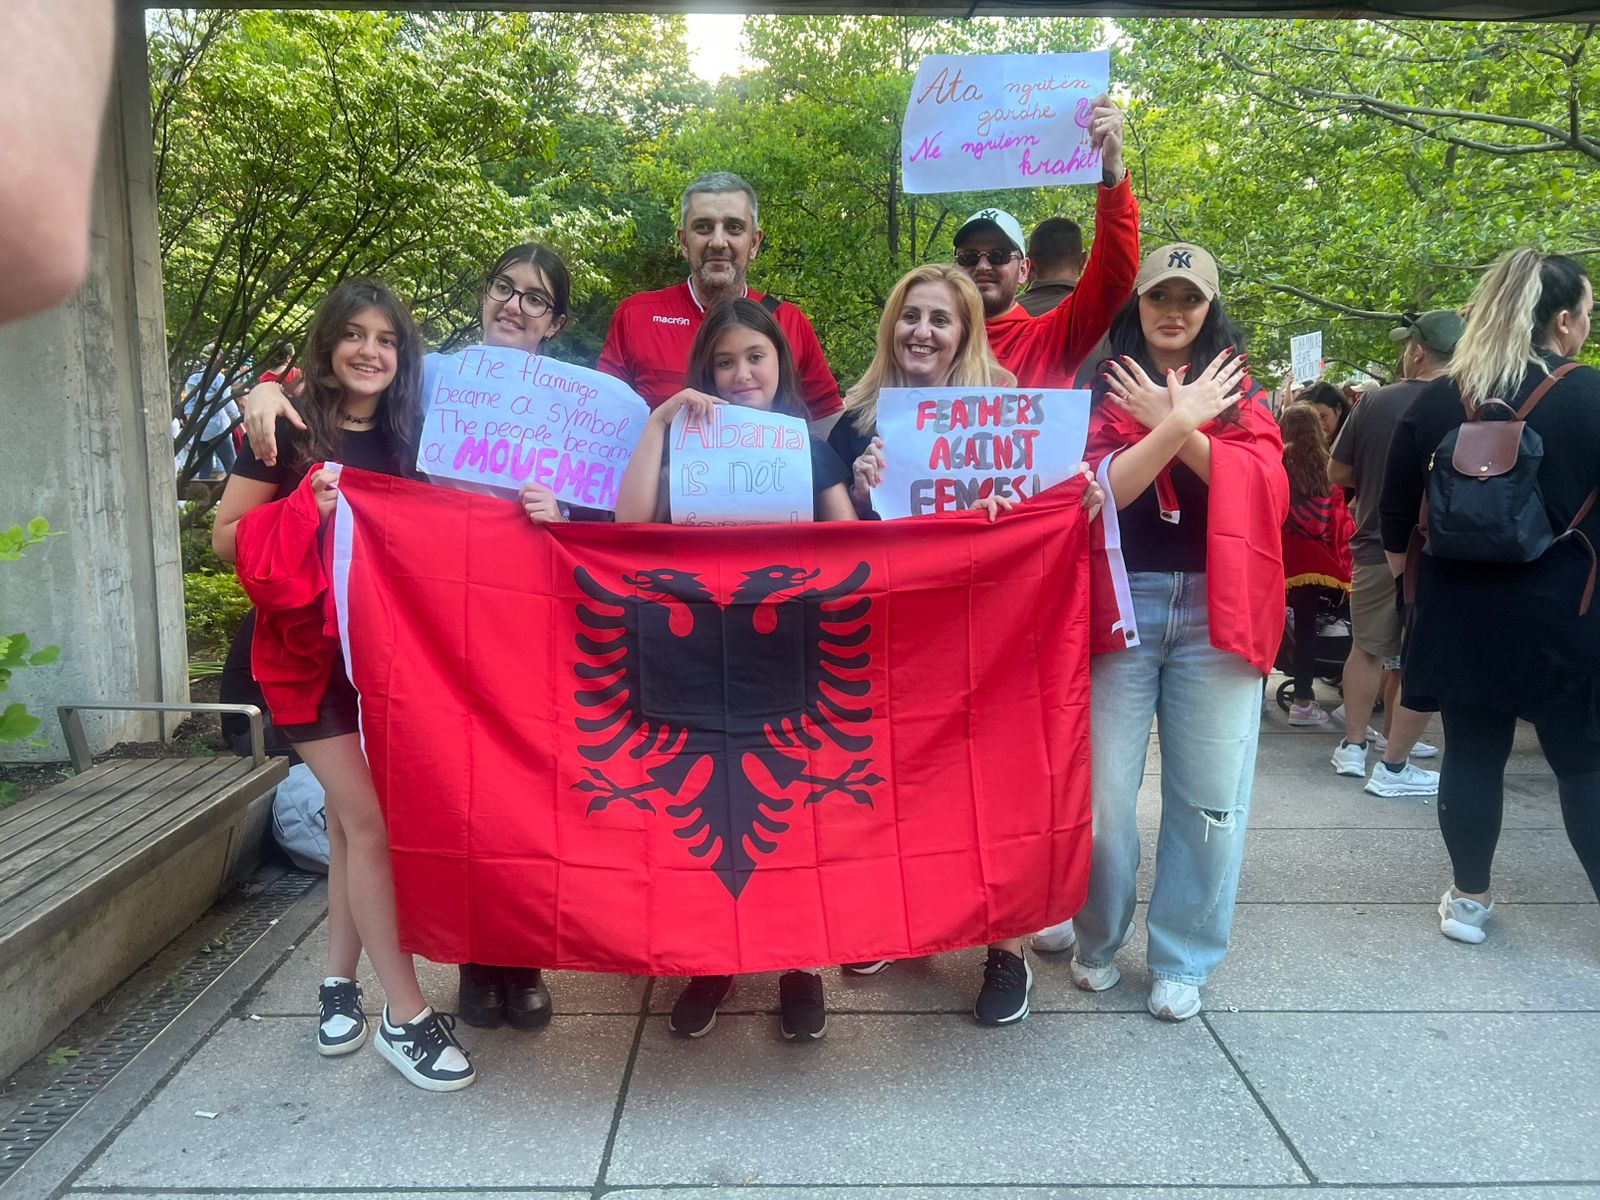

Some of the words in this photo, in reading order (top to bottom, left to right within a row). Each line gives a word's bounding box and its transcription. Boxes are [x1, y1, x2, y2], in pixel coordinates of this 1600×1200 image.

[917, 66, 983, 105] Ata
[909, 131, 943, 162] Ne
[1167, 251, 1193, 269] NY
[652, 315, 690, 326] macron
[434, 376, 501, 409] became
[458, 349, 505, 379] The
[518, 353, 599, 407] flamingo
[434, 408, 477, 435] The
[484, 420, 552, 447] people
[675, 407, 804, 450] Albania
[916, 393, 1046, 433] FEATHERS
[928, 429, 1041, 471] AGAINST
[424, 442, 446, 464] a
[453, 436, 625, 506] MOVEMEN
[681, 461, 709, 496] is
[728, 456, 787, 495] not
